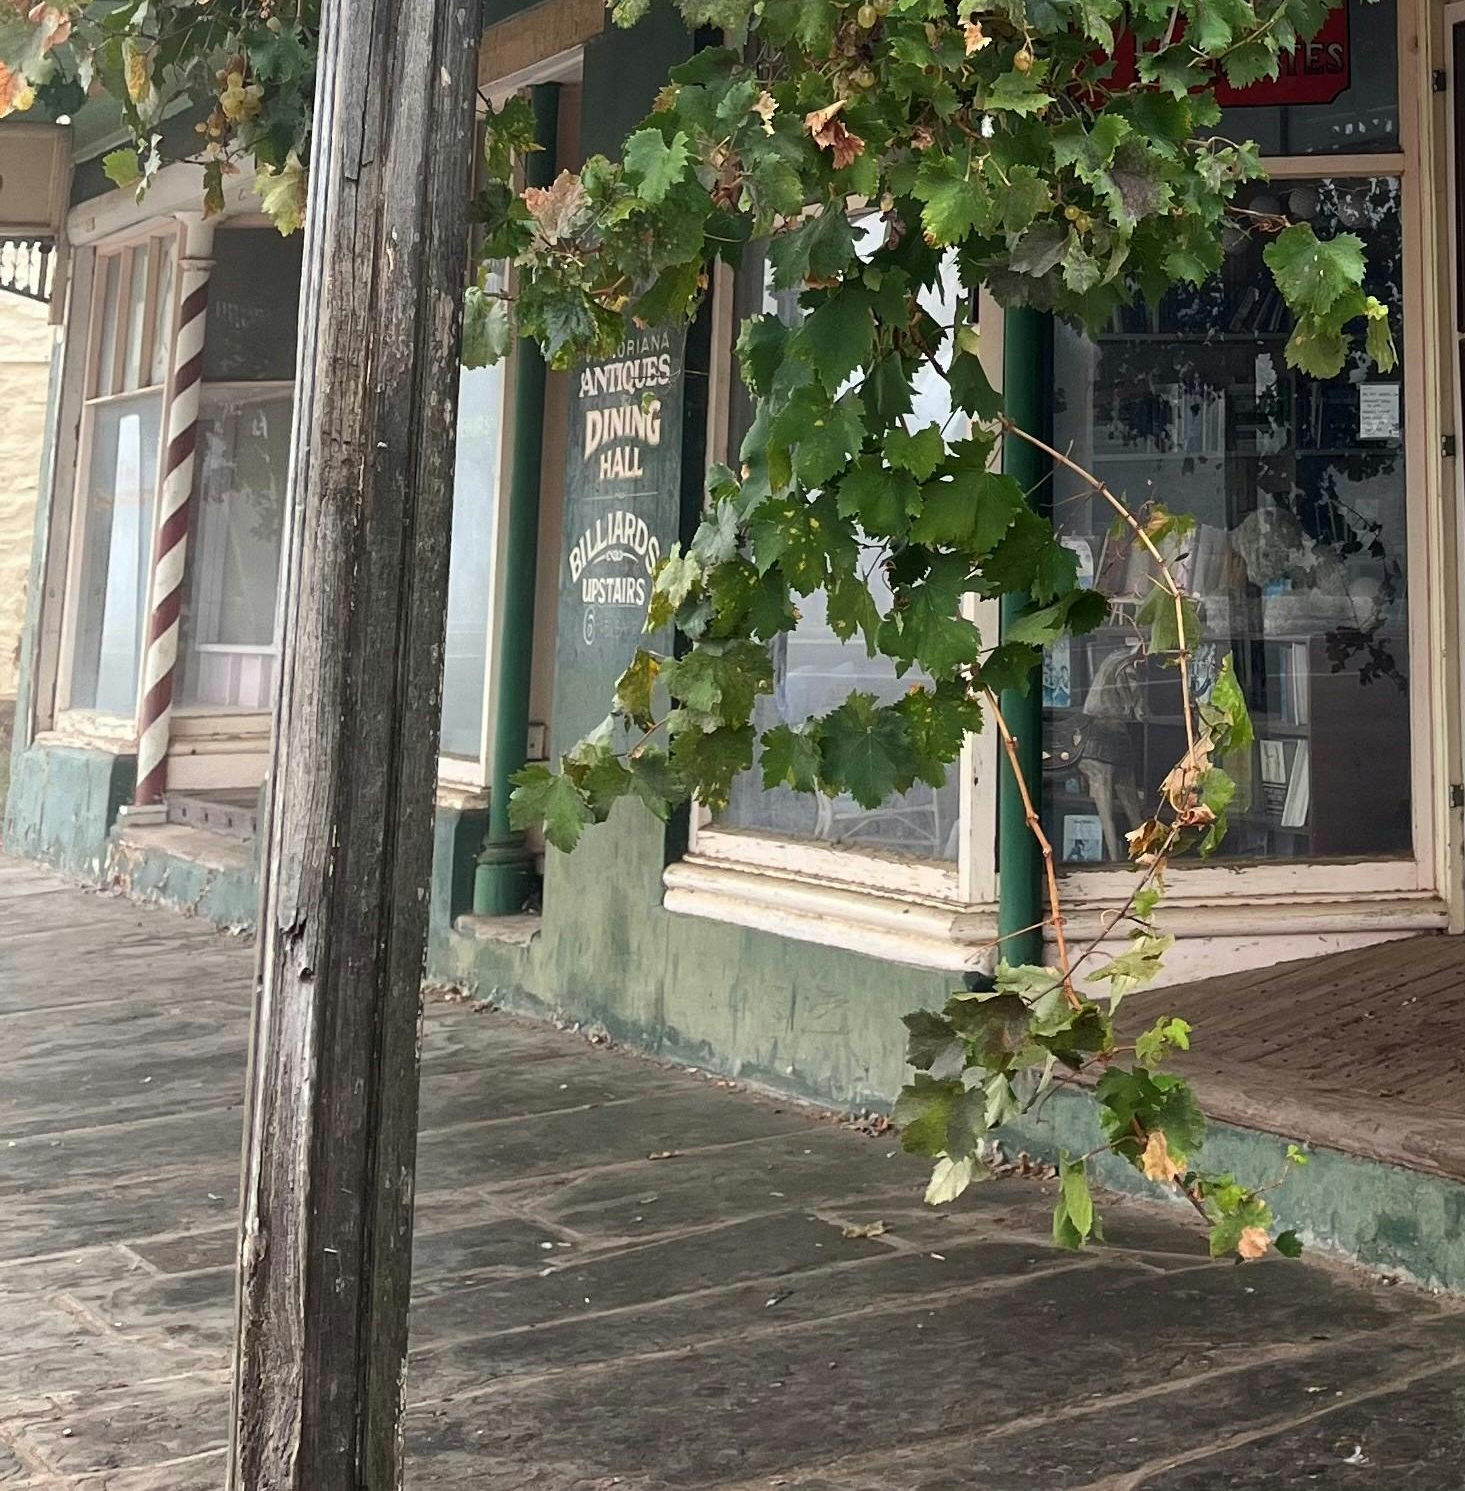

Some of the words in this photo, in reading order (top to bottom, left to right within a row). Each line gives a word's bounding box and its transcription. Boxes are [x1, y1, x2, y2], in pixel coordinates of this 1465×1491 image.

[587, 332, 670, 363] ORIANA
[578, 353, 671, 398] ANTIQUES
[584, 399, 662, 460] DINING
[599, 445, 644, 480] HALL
[569, 510, 661, 584] BILLIARDS
[582, 576, 646, 606] UPSTAIRS
